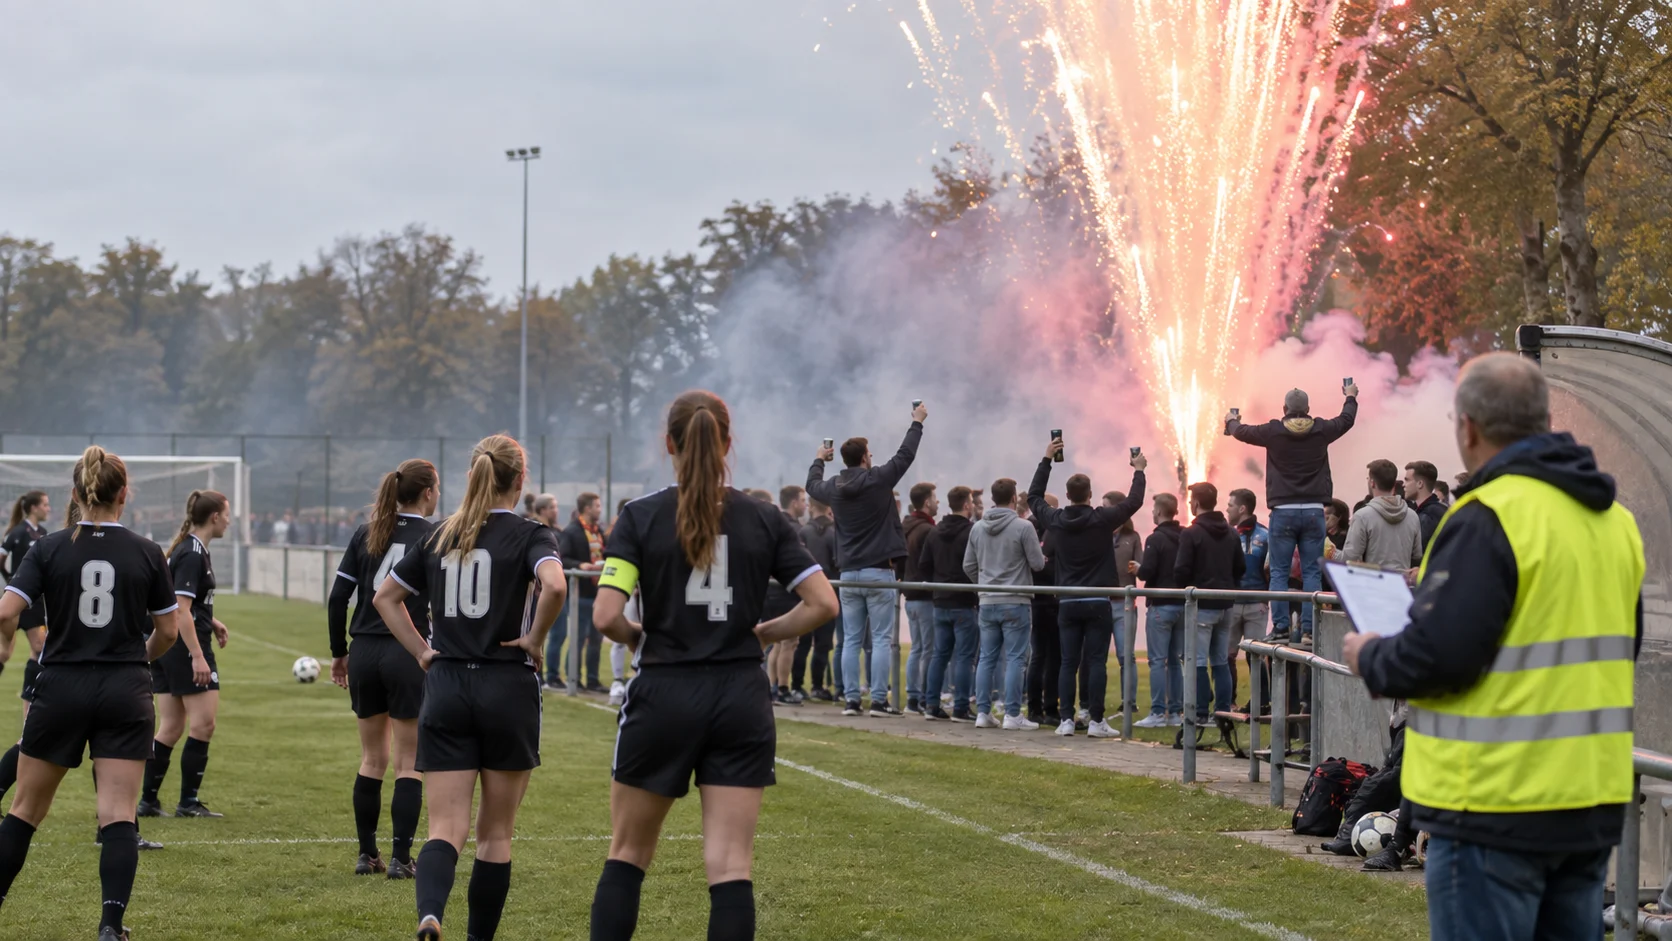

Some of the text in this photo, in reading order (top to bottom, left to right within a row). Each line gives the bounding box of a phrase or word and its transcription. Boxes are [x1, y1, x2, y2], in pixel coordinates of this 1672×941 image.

[78, 559, 116, 628] 8
[441, 548, 491, 619] 10
[685, 535, 733, 621] 4
